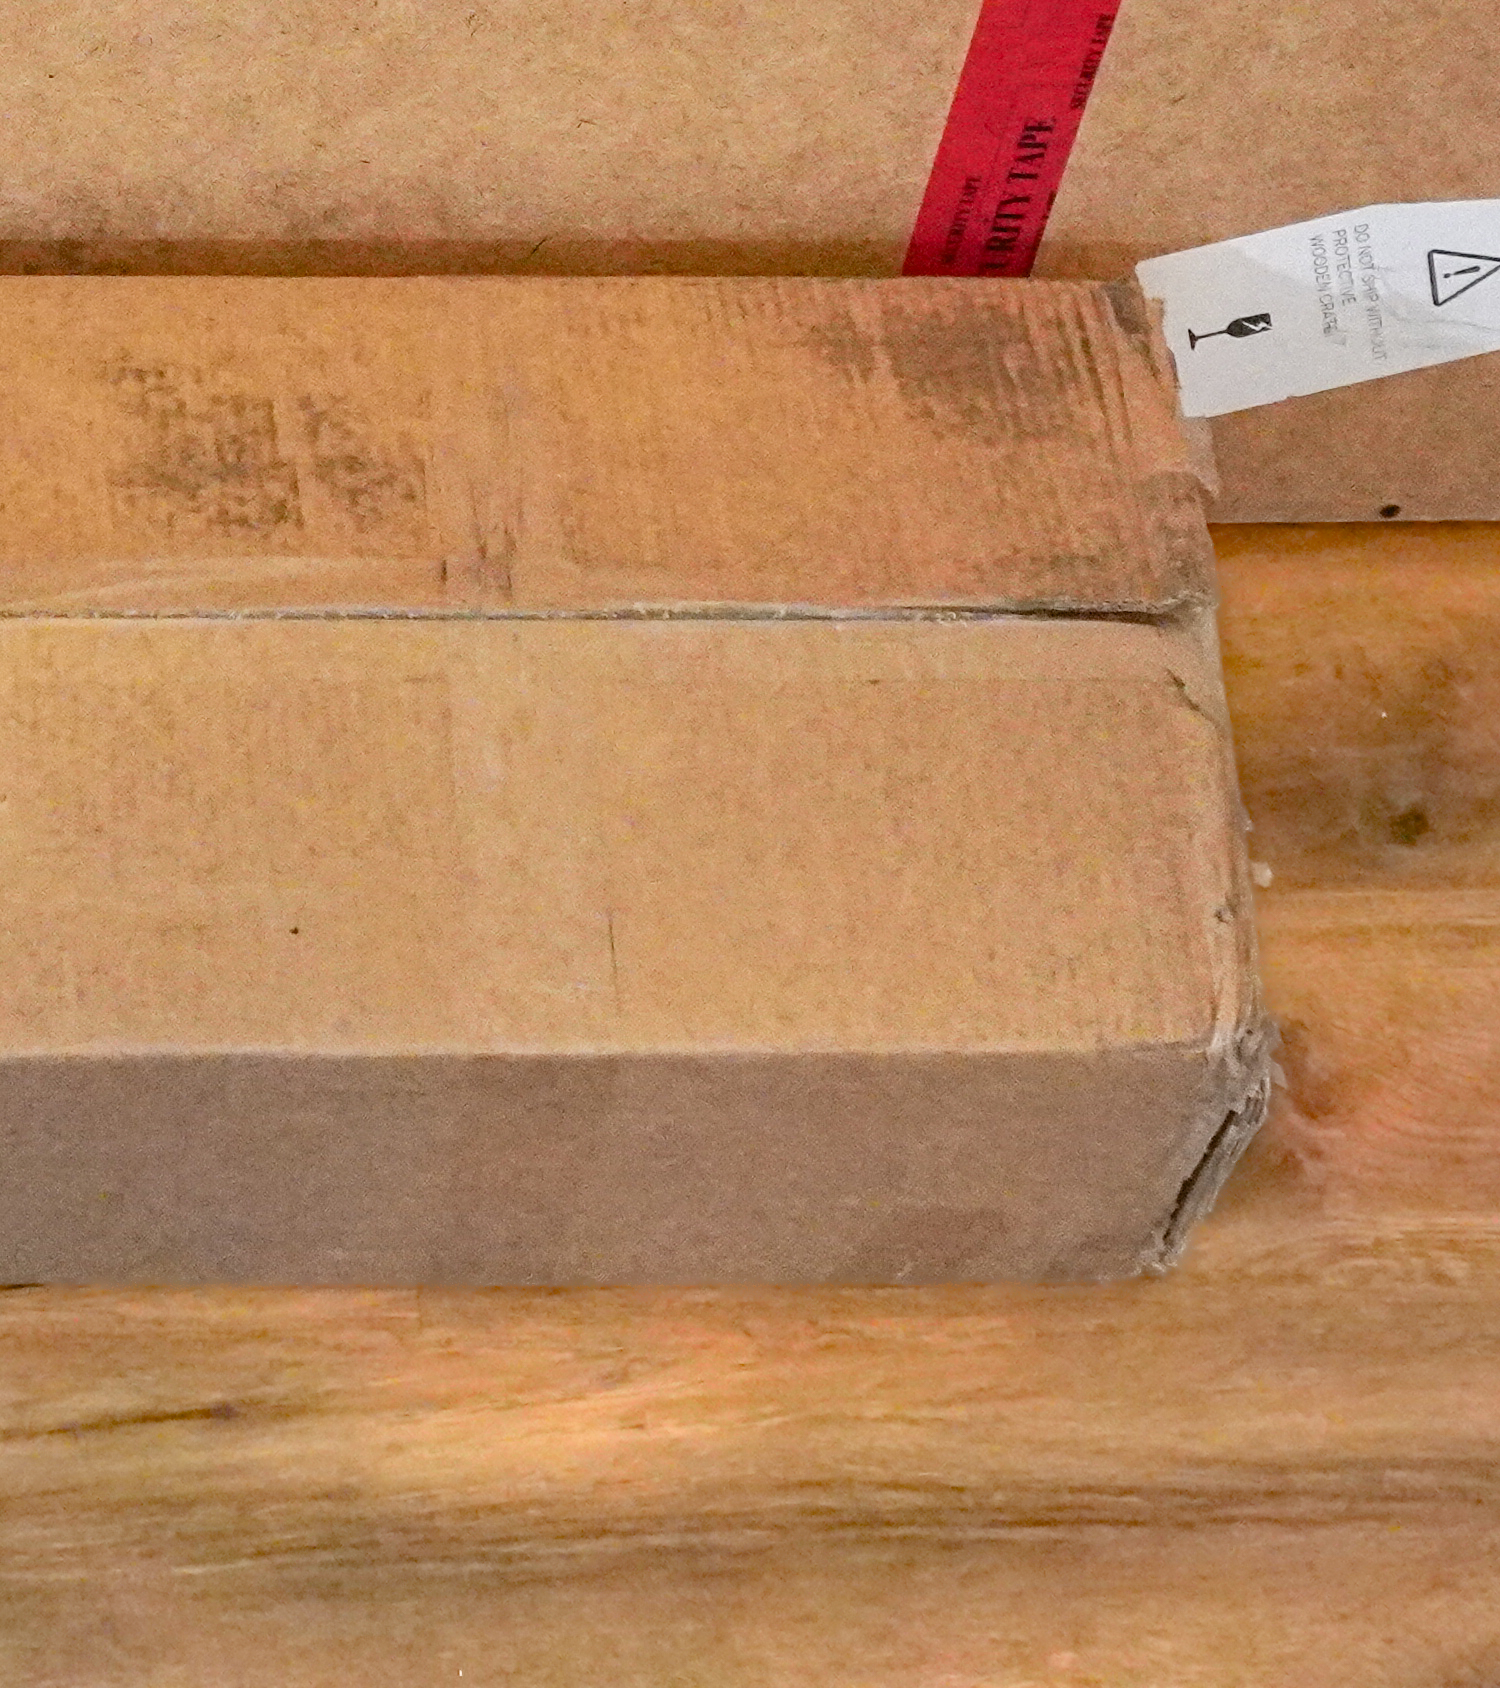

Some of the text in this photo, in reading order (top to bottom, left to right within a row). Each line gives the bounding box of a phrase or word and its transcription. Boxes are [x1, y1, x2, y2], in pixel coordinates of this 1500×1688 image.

[975, 191, 1033, 272] URITY
[1004, 116, 1058, 183] TAPE
[1353, 223, 1371, 243] DO
[1358, 245, 1376, 271] NOT
[1308, 234, 1333, 292] WOODEN
[1331, 229, 1357, 307] PROTECTIVE
